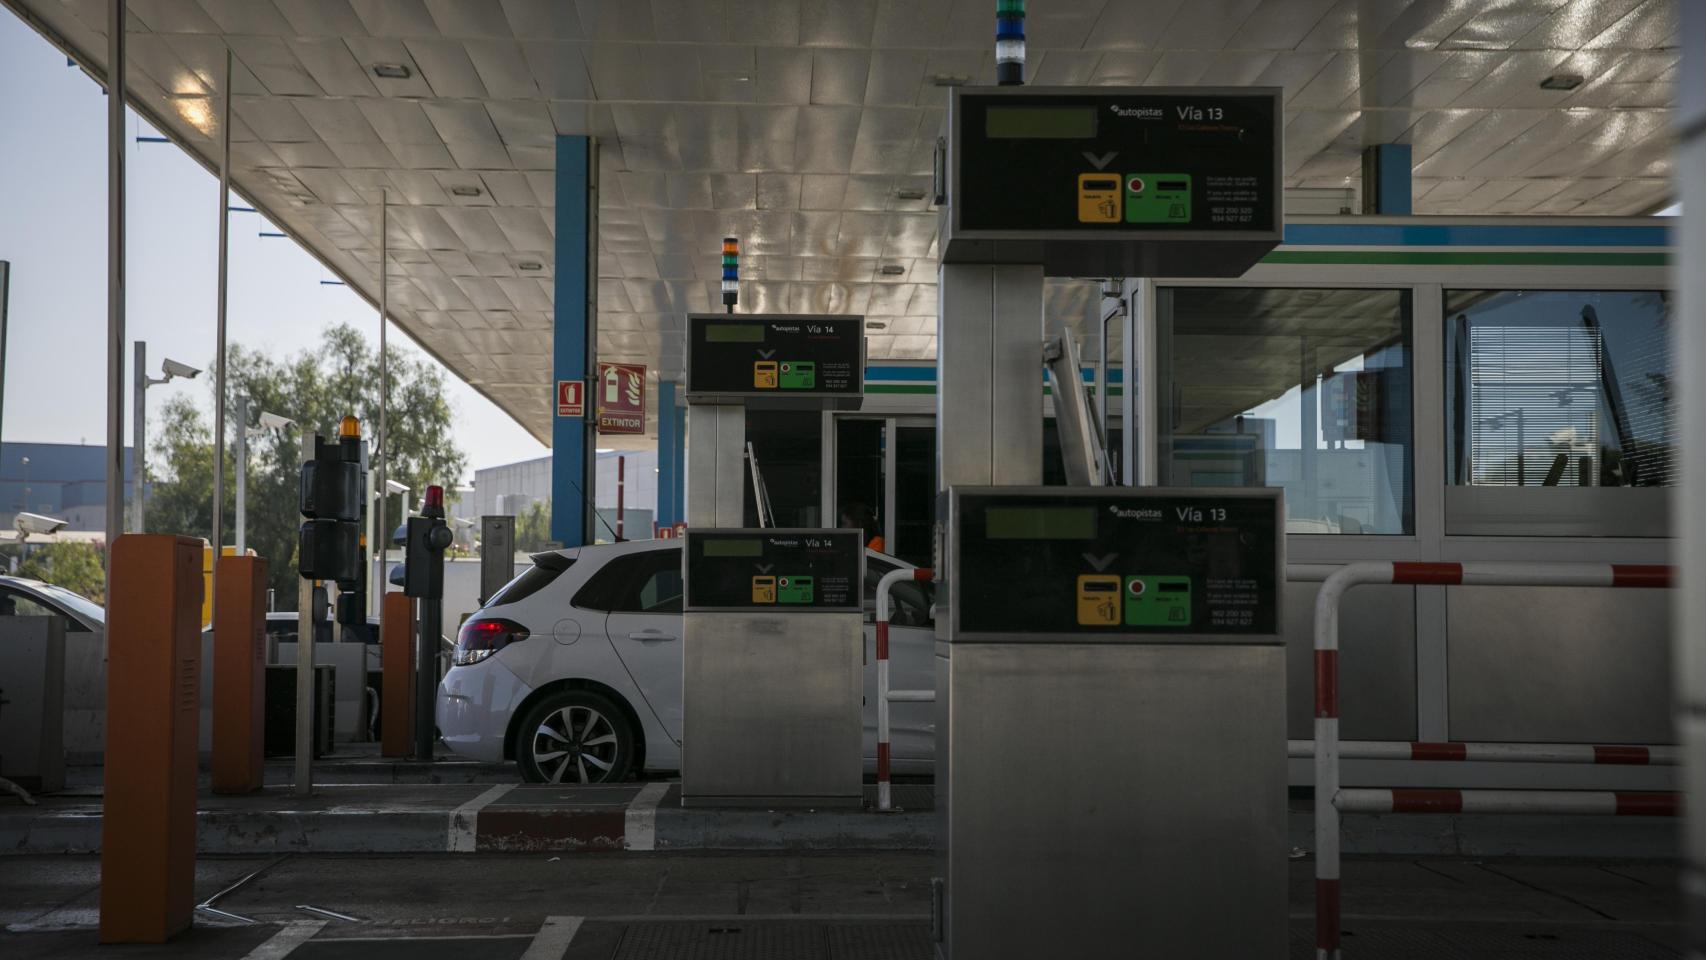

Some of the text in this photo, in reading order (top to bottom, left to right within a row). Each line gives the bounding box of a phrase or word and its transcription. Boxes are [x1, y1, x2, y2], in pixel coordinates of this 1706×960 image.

[1117, 107, 1163, 118] autopistas
[1176, 106, 1224, 120] Vía 13
[807, 324, 834, 334] Vía 14
[601, 417, 641, 428] EXTINTOR
[1116, 508, 1162, 519] autopistas
[1175, 506, 1226, 521] Vía 13
[824, 539, 832, 548] 14
